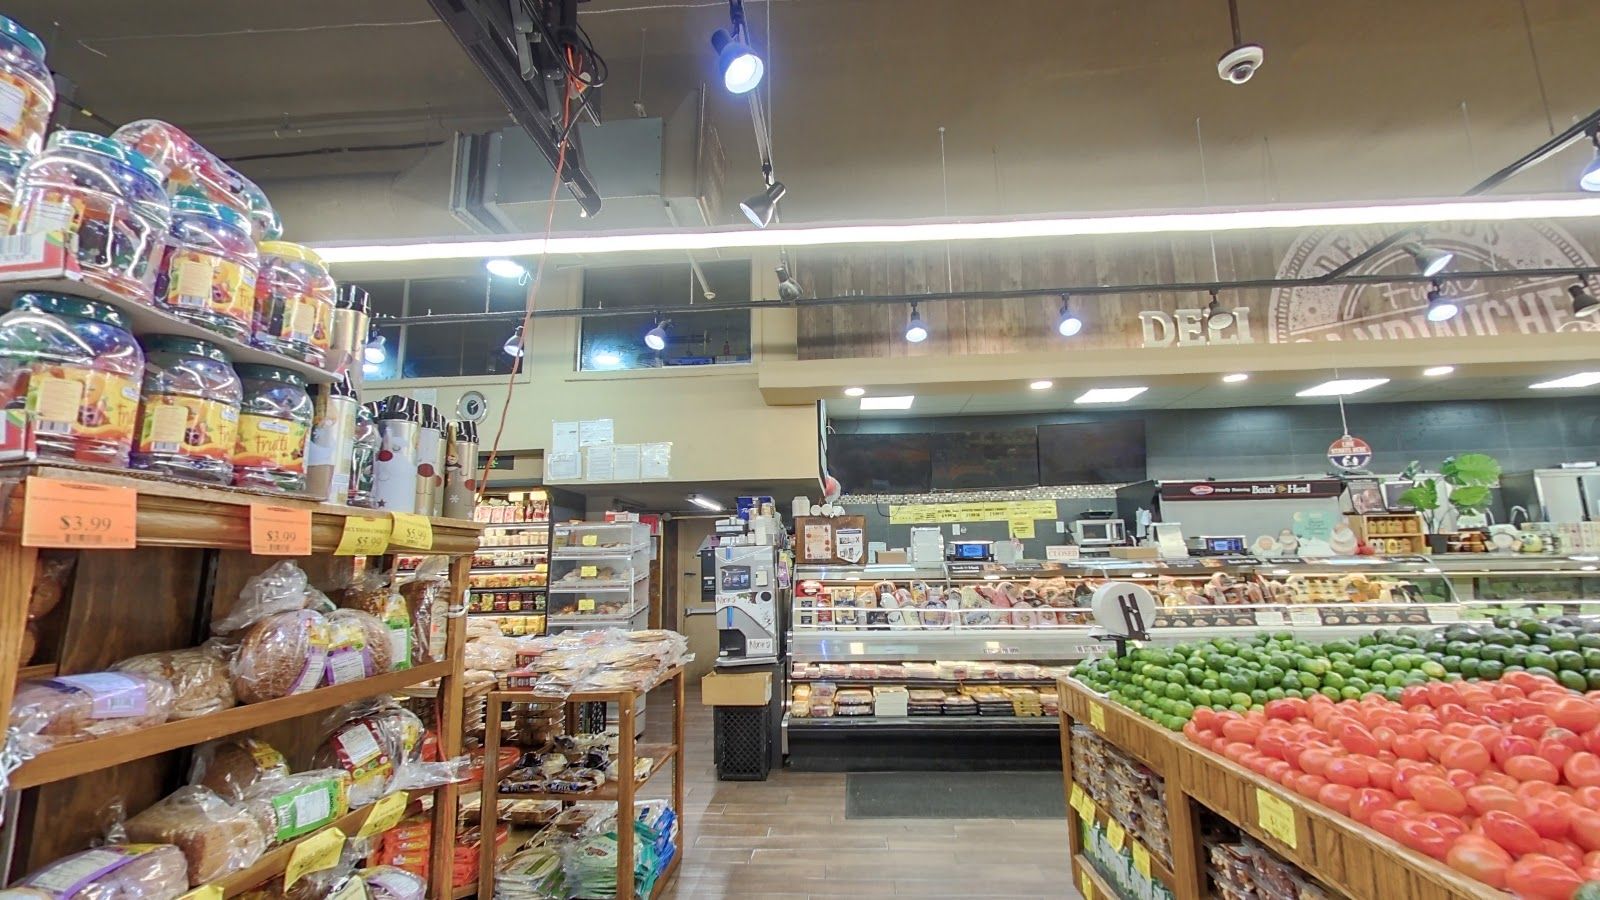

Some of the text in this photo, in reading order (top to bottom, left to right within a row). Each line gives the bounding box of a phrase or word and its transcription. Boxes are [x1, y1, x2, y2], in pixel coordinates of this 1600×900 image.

[1138, 306, 1255, 349] DELI
[59, 514, 112, 532] $3.99
[266, 529, 297, 542] $3.99
